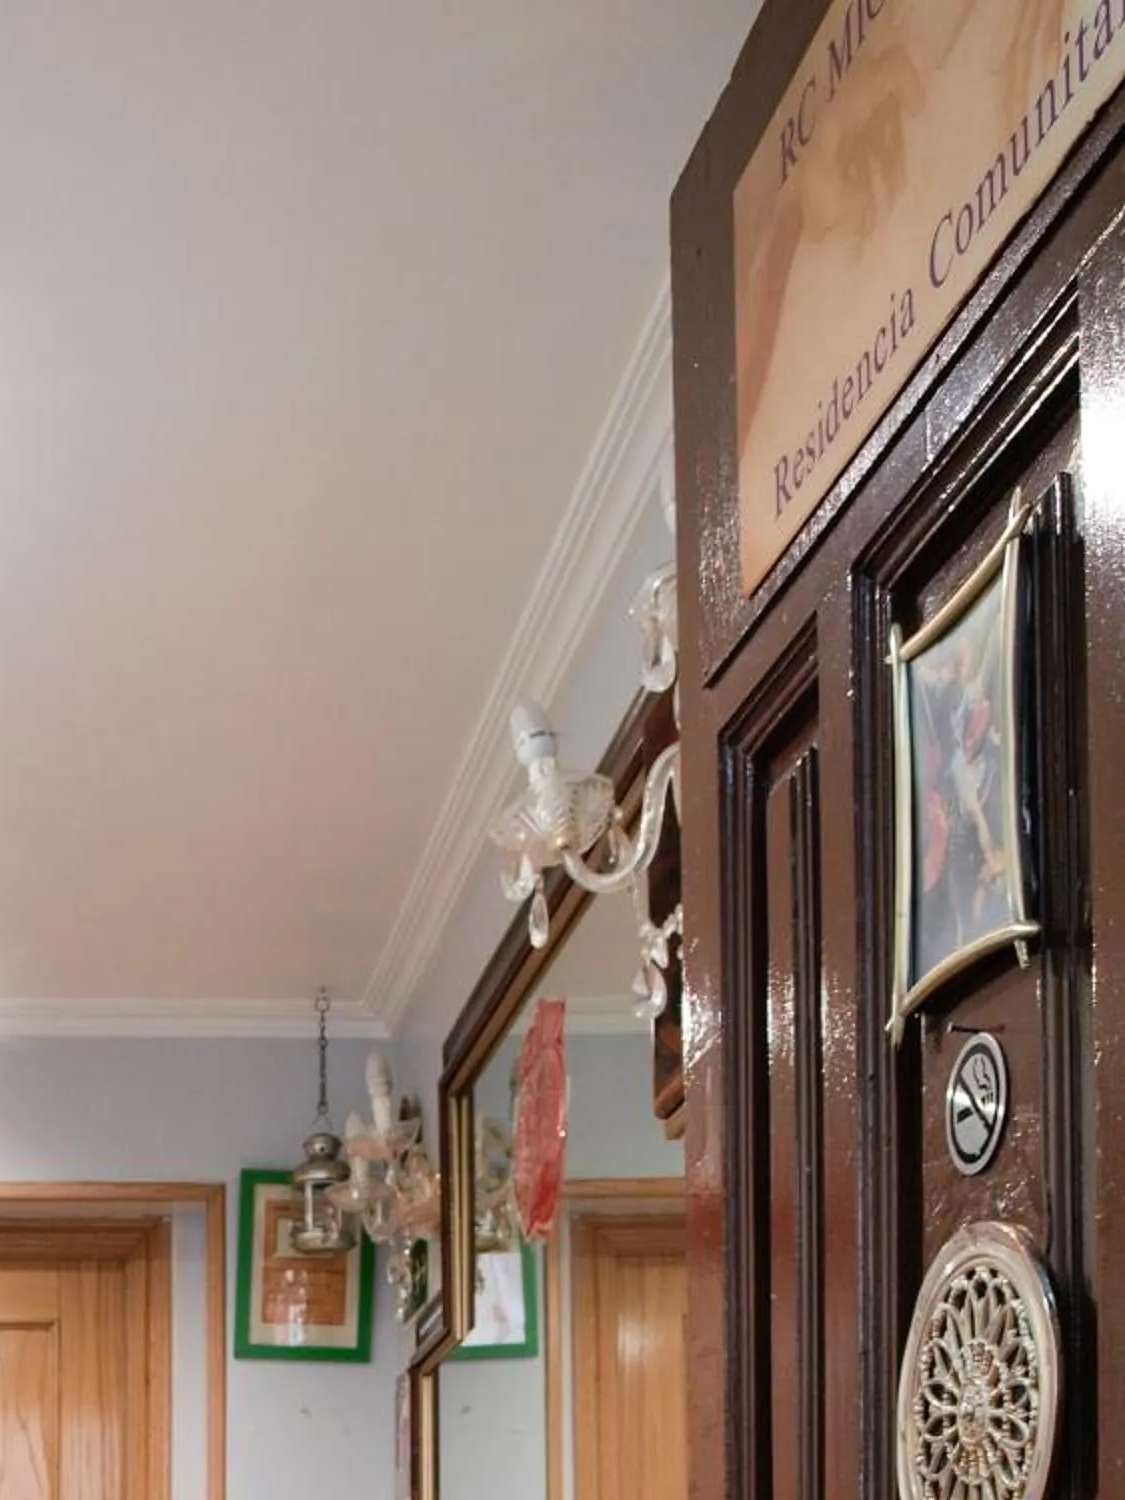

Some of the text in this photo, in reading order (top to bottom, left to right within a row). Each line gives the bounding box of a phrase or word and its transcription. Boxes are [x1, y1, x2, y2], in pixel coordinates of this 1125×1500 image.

[773, 0, 1125, 516] Residencia Comunita
[779, 0, 885, 189] RC MI
